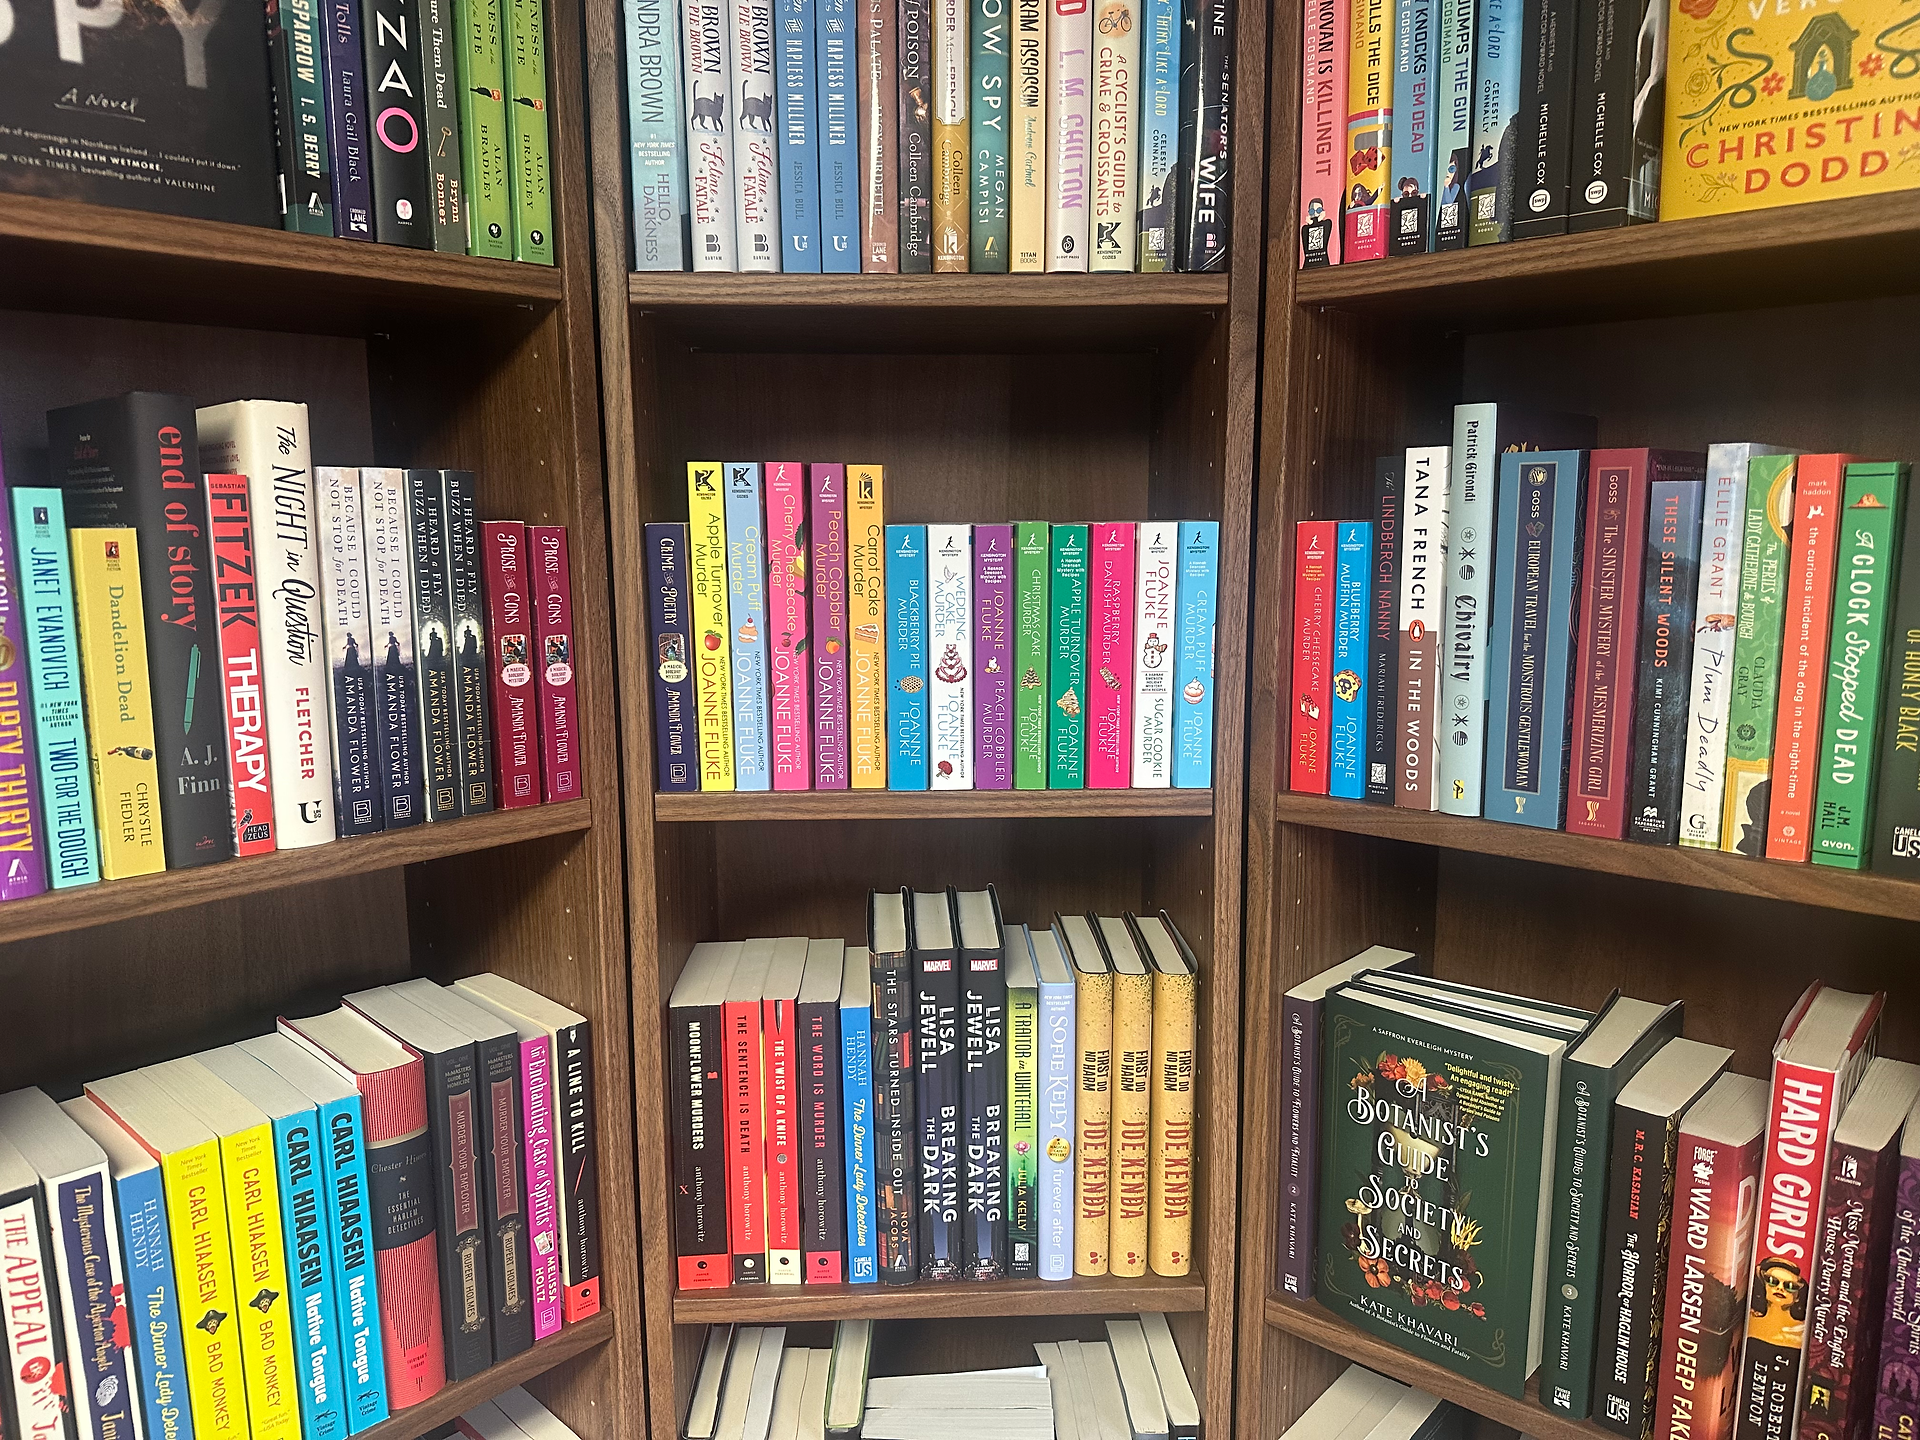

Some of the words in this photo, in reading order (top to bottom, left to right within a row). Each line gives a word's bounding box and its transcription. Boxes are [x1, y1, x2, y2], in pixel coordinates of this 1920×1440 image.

[786, 40, 803, 88] HAPLESS
[1116, 54, 1126, 64] A
[1412, 7, 1427, 75] KNOCKS
[342, 70, 354, 106] Laura
[640, 54, 664, 123] BROWN
[1100, 47, 1112, 97] CRIME
[1412, 78, 1426, 106] 'EM
[61, 87, 77, 104] A
[85, 92, 140, 114] Novel
[300, 98, 314, 108] I.
[302, 113, 316, 126] S.
[788, 94, 805, 146] MILLINER
[982, 75, 1002, 132] SPY
[1099, 102, 1110, 113] &
[1114, 69, 1128, 144] CYCLIST'S
[1220, 74, 1230, 160] SENATOR'S
[1719, 124, 1740, 134] NEW
[1742, 118, 1767, 129] YORK
[1770, 113, 1800, 124] TIMES
[1803, 98, 1876, 118] BESTSELLING
[345, 112, 358, 142] Gail
[1411, 110, 1424, 154] DEAD
[1538, 104, 1548, 158] MICHELLE
[304, 133, 320, 178] BERRY
[347, 144, 362, 182] Black
[480, 124, 492, 202] BRADLEY
[494, 143, 504, 187] ALAN
[700, 142, 726, 196] Feline
[910, 132, 920, 183] Colleen
[1097, 119, 1110, 216] CROISSANTS
[1113, 150, 1126, 198] GUIDE
[1536, 161, 1546, 185] COX
[1744, 150, 1888, 194] DODD
[657, 172, 672, 225] HELLO,
[694, 176, 710, 224] FATALE
[979, 150, 990, 224] CAMPISI
[995, 154, 1004, 219] MEGAN
[1112, 202, 1121, 213] to
[1198, 156, 1216, 224] WIFE
[643, 185, 658, 262] DARKNESS
[906, 185, 920, 257] Cambridge
[157, 426, 196, 490] end
[276, 426, 298, 458] The
[272, 464, 308, 550] NIGHT
[1414, 457, 1430, 518] TANA
[165, 502, 198, 538] of
[706, 512, 721, 559] Apple
[1663, 495, 1679, 544] THESE
[1854, 528, 1875, 550] A
[31, 547, 60, 596] JANET
[211, 492, 256, 630] FITZEK
[286, 549, 303, 572] in
[694, 543, 708, 598] Murder
[1411, 528, 1427, 610] FRENCH
[1659, 551, 1676, 606] SILENT
[161, 545, 196, 632] story
[708, 564, 724, 627] Turnover
[1846, 554, 1873, 625] CLOCK
[272, 578, 318, 667] Question
[898, 597, 910, 652] MURDER
[909, 580, 920, 650] BLACKBERRY
[36, 606, 70, 692] EVANOVICH
[108, 586, 126, 676] Dandelion
[118, 680, 135, 722] Dead
[910, 653, 920, 669] PIE
[1409, 650, 1422, 670] IN
[1654, 614, 1672, 668] WOODS
[701, 654, 718, 726] JOANNE
[1408, 678, 1420, 712] THE
[1831, 628, 1870, 723] Stopped
[227, 648, 267, 794] THERAPY
[295, 686, 314, 780] FLETCHER
[1142, 716, 1154, 764] MURDER
[1153, 698, 1164, 735] SUGAR
[48, 737, 78, 772] TWO
[180, 746, 197, 767] A.
[204, 744, 218, 766] J.
[704, 732, 720, 780] FLUKE
[1152, 738, 1162, 778] COOKIE
[1405, 719, 1420, 792] WOODS
[1832, 728, 1859, 784] DEAD
[54, 775, 79, 799] FOR
[178, 776, 220, 797] Finn
[57, 802, 82, 827] THE
[118, 791, 134, 843] FIEDLER
[136, 782, 152, 847] CHRYSTLE
[246, 824, 266, 835] HEAD
[246, 831, 268, 842] ZEUS
[1821, 800, 1835, 829] HALL
[1838, 804, 1850, 829] J.M.
[58, 828, 90, 879] DOUGH
[1821, 838, 1854, 850] avon.
[885, 970, 896, 995] THE
[924, 960, 951, 972] MARVEL
[886, 1002, 898, 1044] STARS
[920, 990, 938, 1074] JEWELL
[939, 1006, 954, 1056] LISA
[568, 1049, 580, 1058] A
[688, 1022, 702, 1095] MOONFLOWER
[1082, 1064, 1094, 1092] HARM
[1084, 1050, 1096, 1062] NO
[1097, 1050, 1110, 1079] FIRST
[568, 1064, 582, 1095] LINE
[888, 1052, 900, 1106] TURNED
[1097, 1082, 1107, 1092] DO
[1394, 1078, 1426, 1101] A
[570, 1098, 583, 1118] TO
[691, 1098, 704, 1150] MURDERS
[926, 1117, 936, 1140] THE
[1346, 1086, 1488, 1157] BOTANIST'S
[1776, 1077, 1823, 1166] HARD
[330, 1112, 352, 1170] CARL
[570, 1124, 585, 1154] KILL
[890, 1114, 901, 1160] INSIDE
[1082, 1120, 1108, 1151] JOE
[1378, 1130, 1448, 1182] GUIDE
[892, 1167, 903, 1196] OUT
[922, 1145, 940, 1214] DARK
[940, 1105, 958, 1222] BREAKING
[1082, 1157, 1108, 1218] KENDA
[1404, 1176, 1418, 1190] TO
[244, 1168, 264, 1210] CARL
[388, 1197, 420, 1214] ESSENTIAL
[398, 1190, 410, 1200] THE
[1358, 1174, 1465, 1232] SOCIETY
[4, 1214, 28, 1249] THE
[336, 1172, 365, 1272] HIAASEN
[388, 1216, 424, 1234] DETECTIVES
[393, 1208, 418, 1223] HARLEM
[1398, 1222, 1420, 1240] AND
[1686, 1186, 1711, 1249] WARD
[1766, 1171, 1812, 1259] GIRLS
[247, 1211, 270, 1284] HIAASEN
[1358, 1224, 1464, 1290] SECRETS
[348, 1273, 364, 1327] Native
[536, 1266, 544, 1303] HOLTZ
[546, 1256, 555, 1304] MELISSA
[1679, 1260, 1705, 1334] LARSEN
[4, 1255, 48, 1355] APPEAL
[1360, 1294, 1392, 1318] KATE
[1398, 1306, 1458, 1348] KHAVARI
[259, 1320, 275, 1352] BAD
[350, 1326, 369, 1384] Tongue
[261, 1354, 280, 1409] MONKEY
[1674, 1338, 1698, 1392] DEEP
